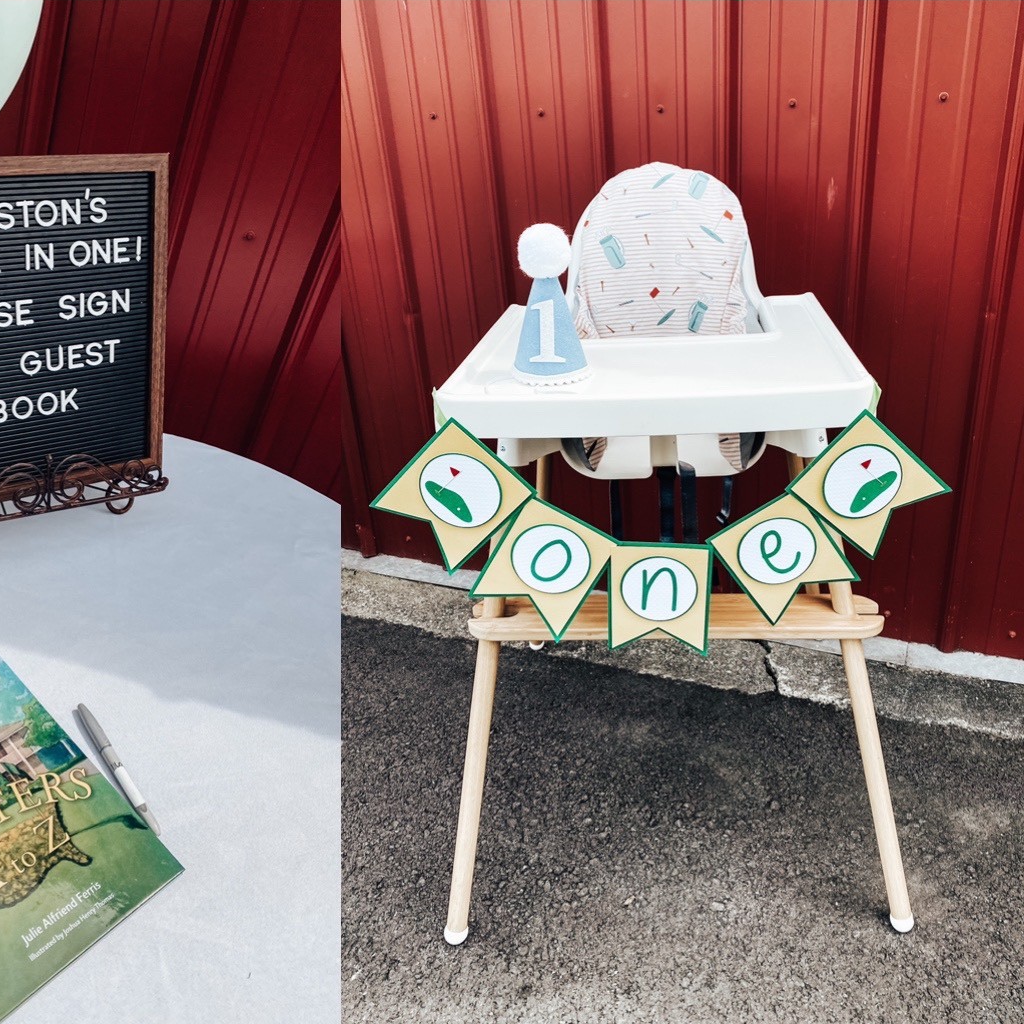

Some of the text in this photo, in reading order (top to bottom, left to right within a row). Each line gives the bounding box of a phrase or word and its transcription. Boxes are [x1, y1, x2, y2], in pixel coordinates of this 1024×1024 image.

[25, 242, 55, 271] IN
[68, 236, 143, 268] ONE!
[58, 288, 131, 321] SIGN
[529, 299, 567, 364] 1
[19, 338, 121, 377] GUEST
[10, 851, 38, 874] to
[33, 815, 70, 853] Z
[20, 881, 102, 949] Julie Alfriend Ferris
